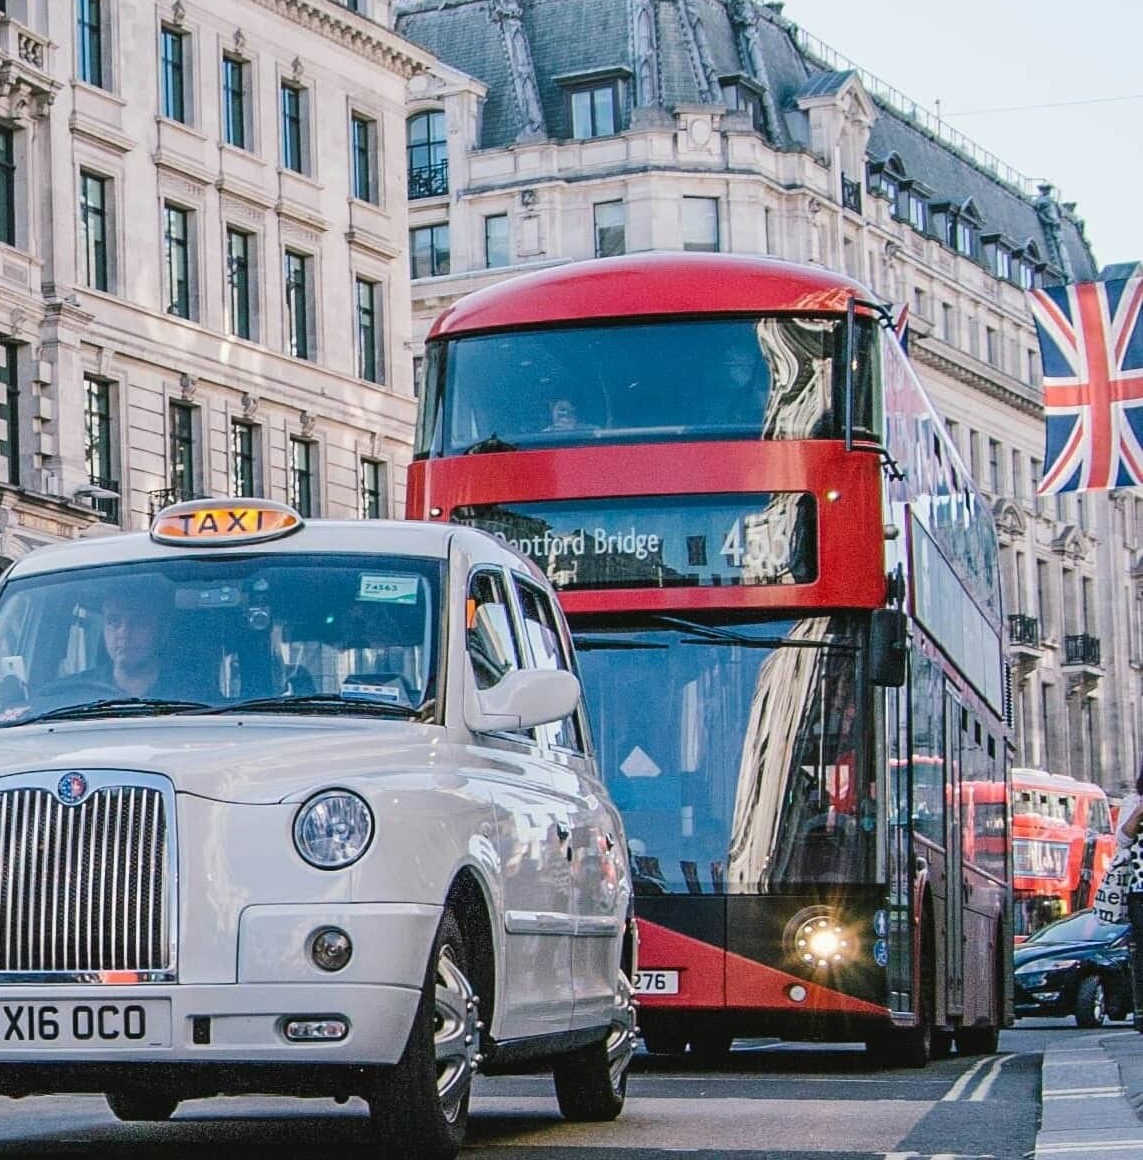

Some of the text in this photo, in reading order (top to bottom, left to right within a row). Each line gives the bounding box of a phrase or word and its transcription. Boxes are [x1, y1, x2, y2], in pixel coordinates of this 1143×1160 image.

[178, 511, 263, 536] TAXI
[594, 526, 659, 559] Bridge
[73, 1005, 145, 1040] OCO
